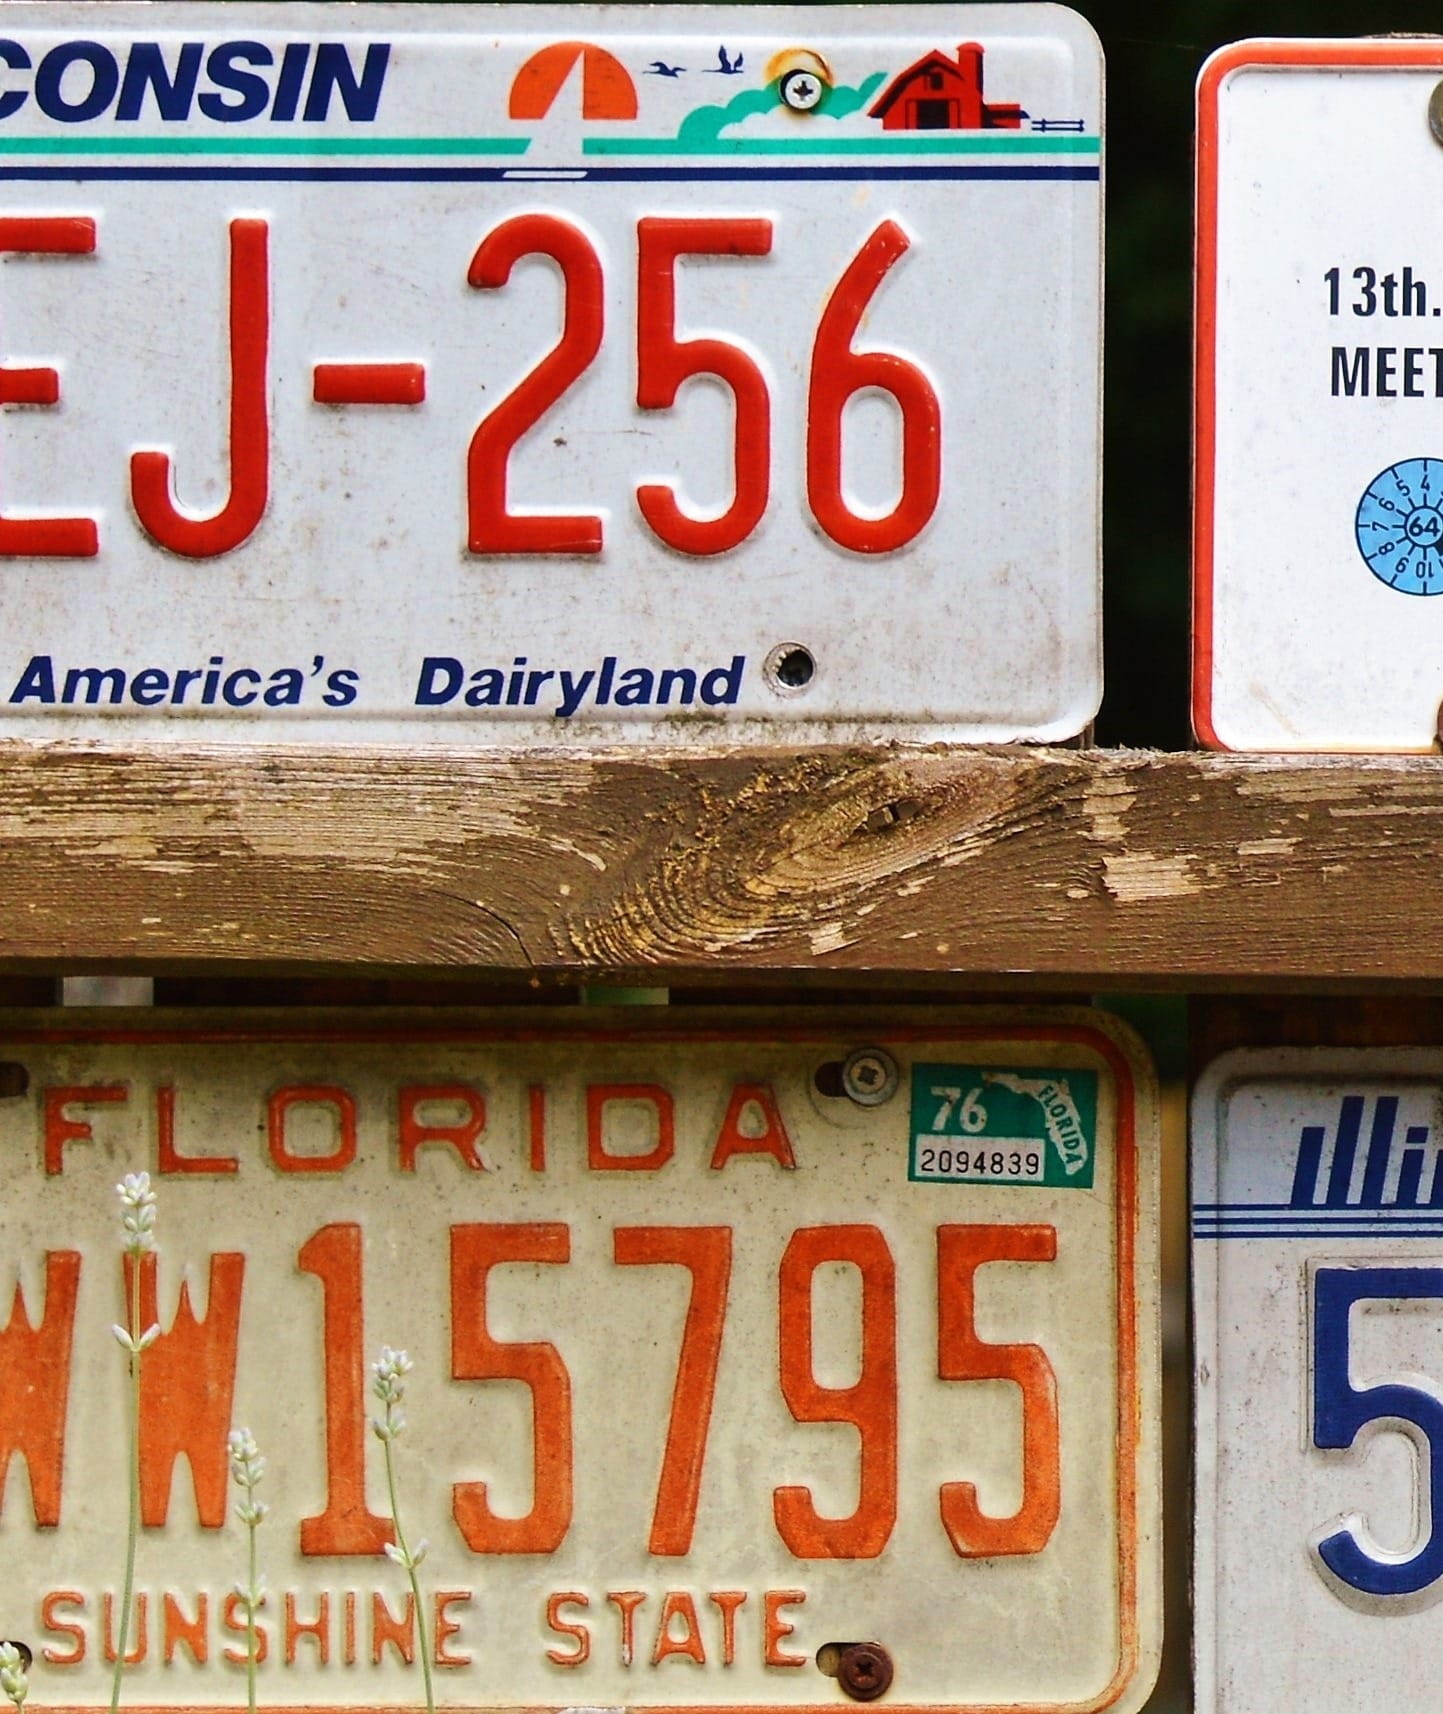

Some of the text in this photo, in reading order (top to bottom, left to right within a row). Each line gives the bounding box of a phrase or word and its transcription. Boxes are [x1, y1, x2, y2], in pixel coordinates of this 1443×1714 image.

[1325, 267, 1440, 316] 13th.
[1396, 480, 1410, 496] 5
[1420, 475, 1431, 491] 4
[1379, 498, 1395, 511] 6
[1372, 521, 1389, 532] 7
[1409, 516, 1440, 537] 64
[1378, 542, 1395, 555] 8
[1396, 557, 1409, 573] 9
[1416, 561, 1434, 578] 10
[9, 655, 745, 718] America's Dairyland
[931, 1086, 987, 1132] 76
[44, 1083, 797, 1174] FLORIDA
[1037, 1085, 1083, 1165] FLORIDA
[921, 1149, 1040, 1175] 2094839
[41, 1591, 806, 1668] SUNSHINE STATE
